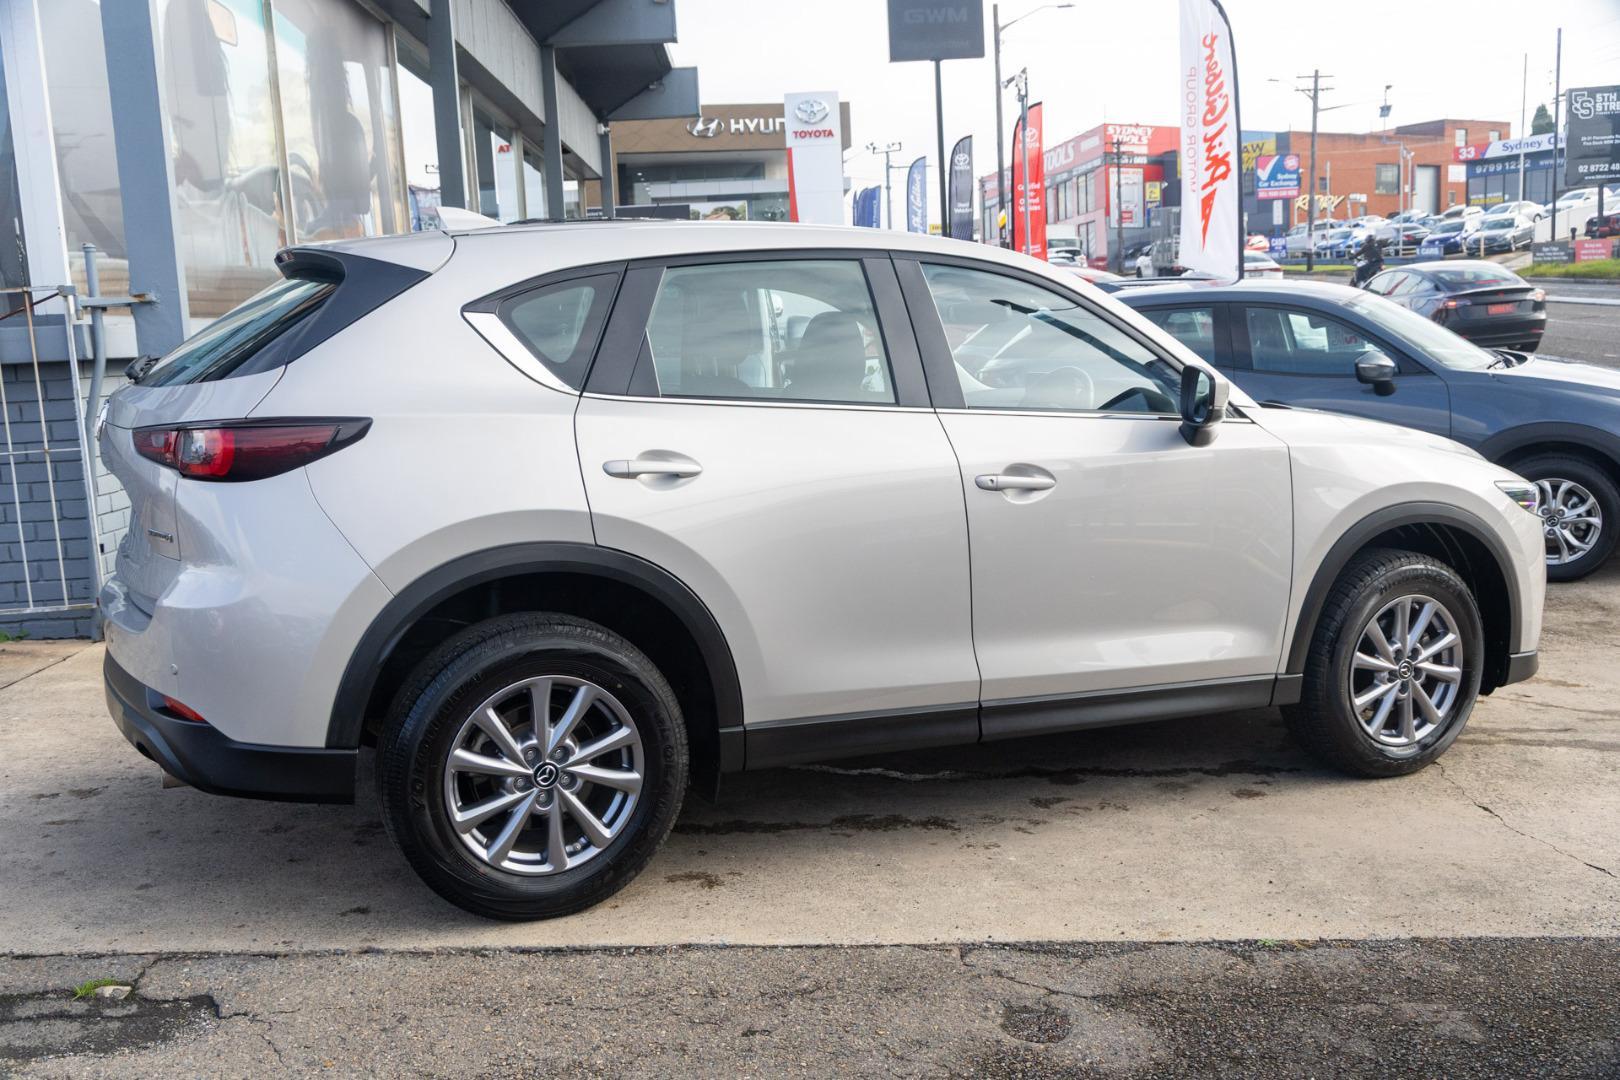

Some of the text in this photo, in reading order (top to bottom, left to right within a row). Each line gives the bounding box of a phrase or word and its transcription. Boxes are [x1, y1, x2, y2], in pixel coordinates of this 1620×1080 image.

[903, 7, 968, 24] GWM
[793, 129, 834, 139] TOYOTA
[1501, 139, 1543, 152] Sydney
[1458, 147, 1476, 160] 33
